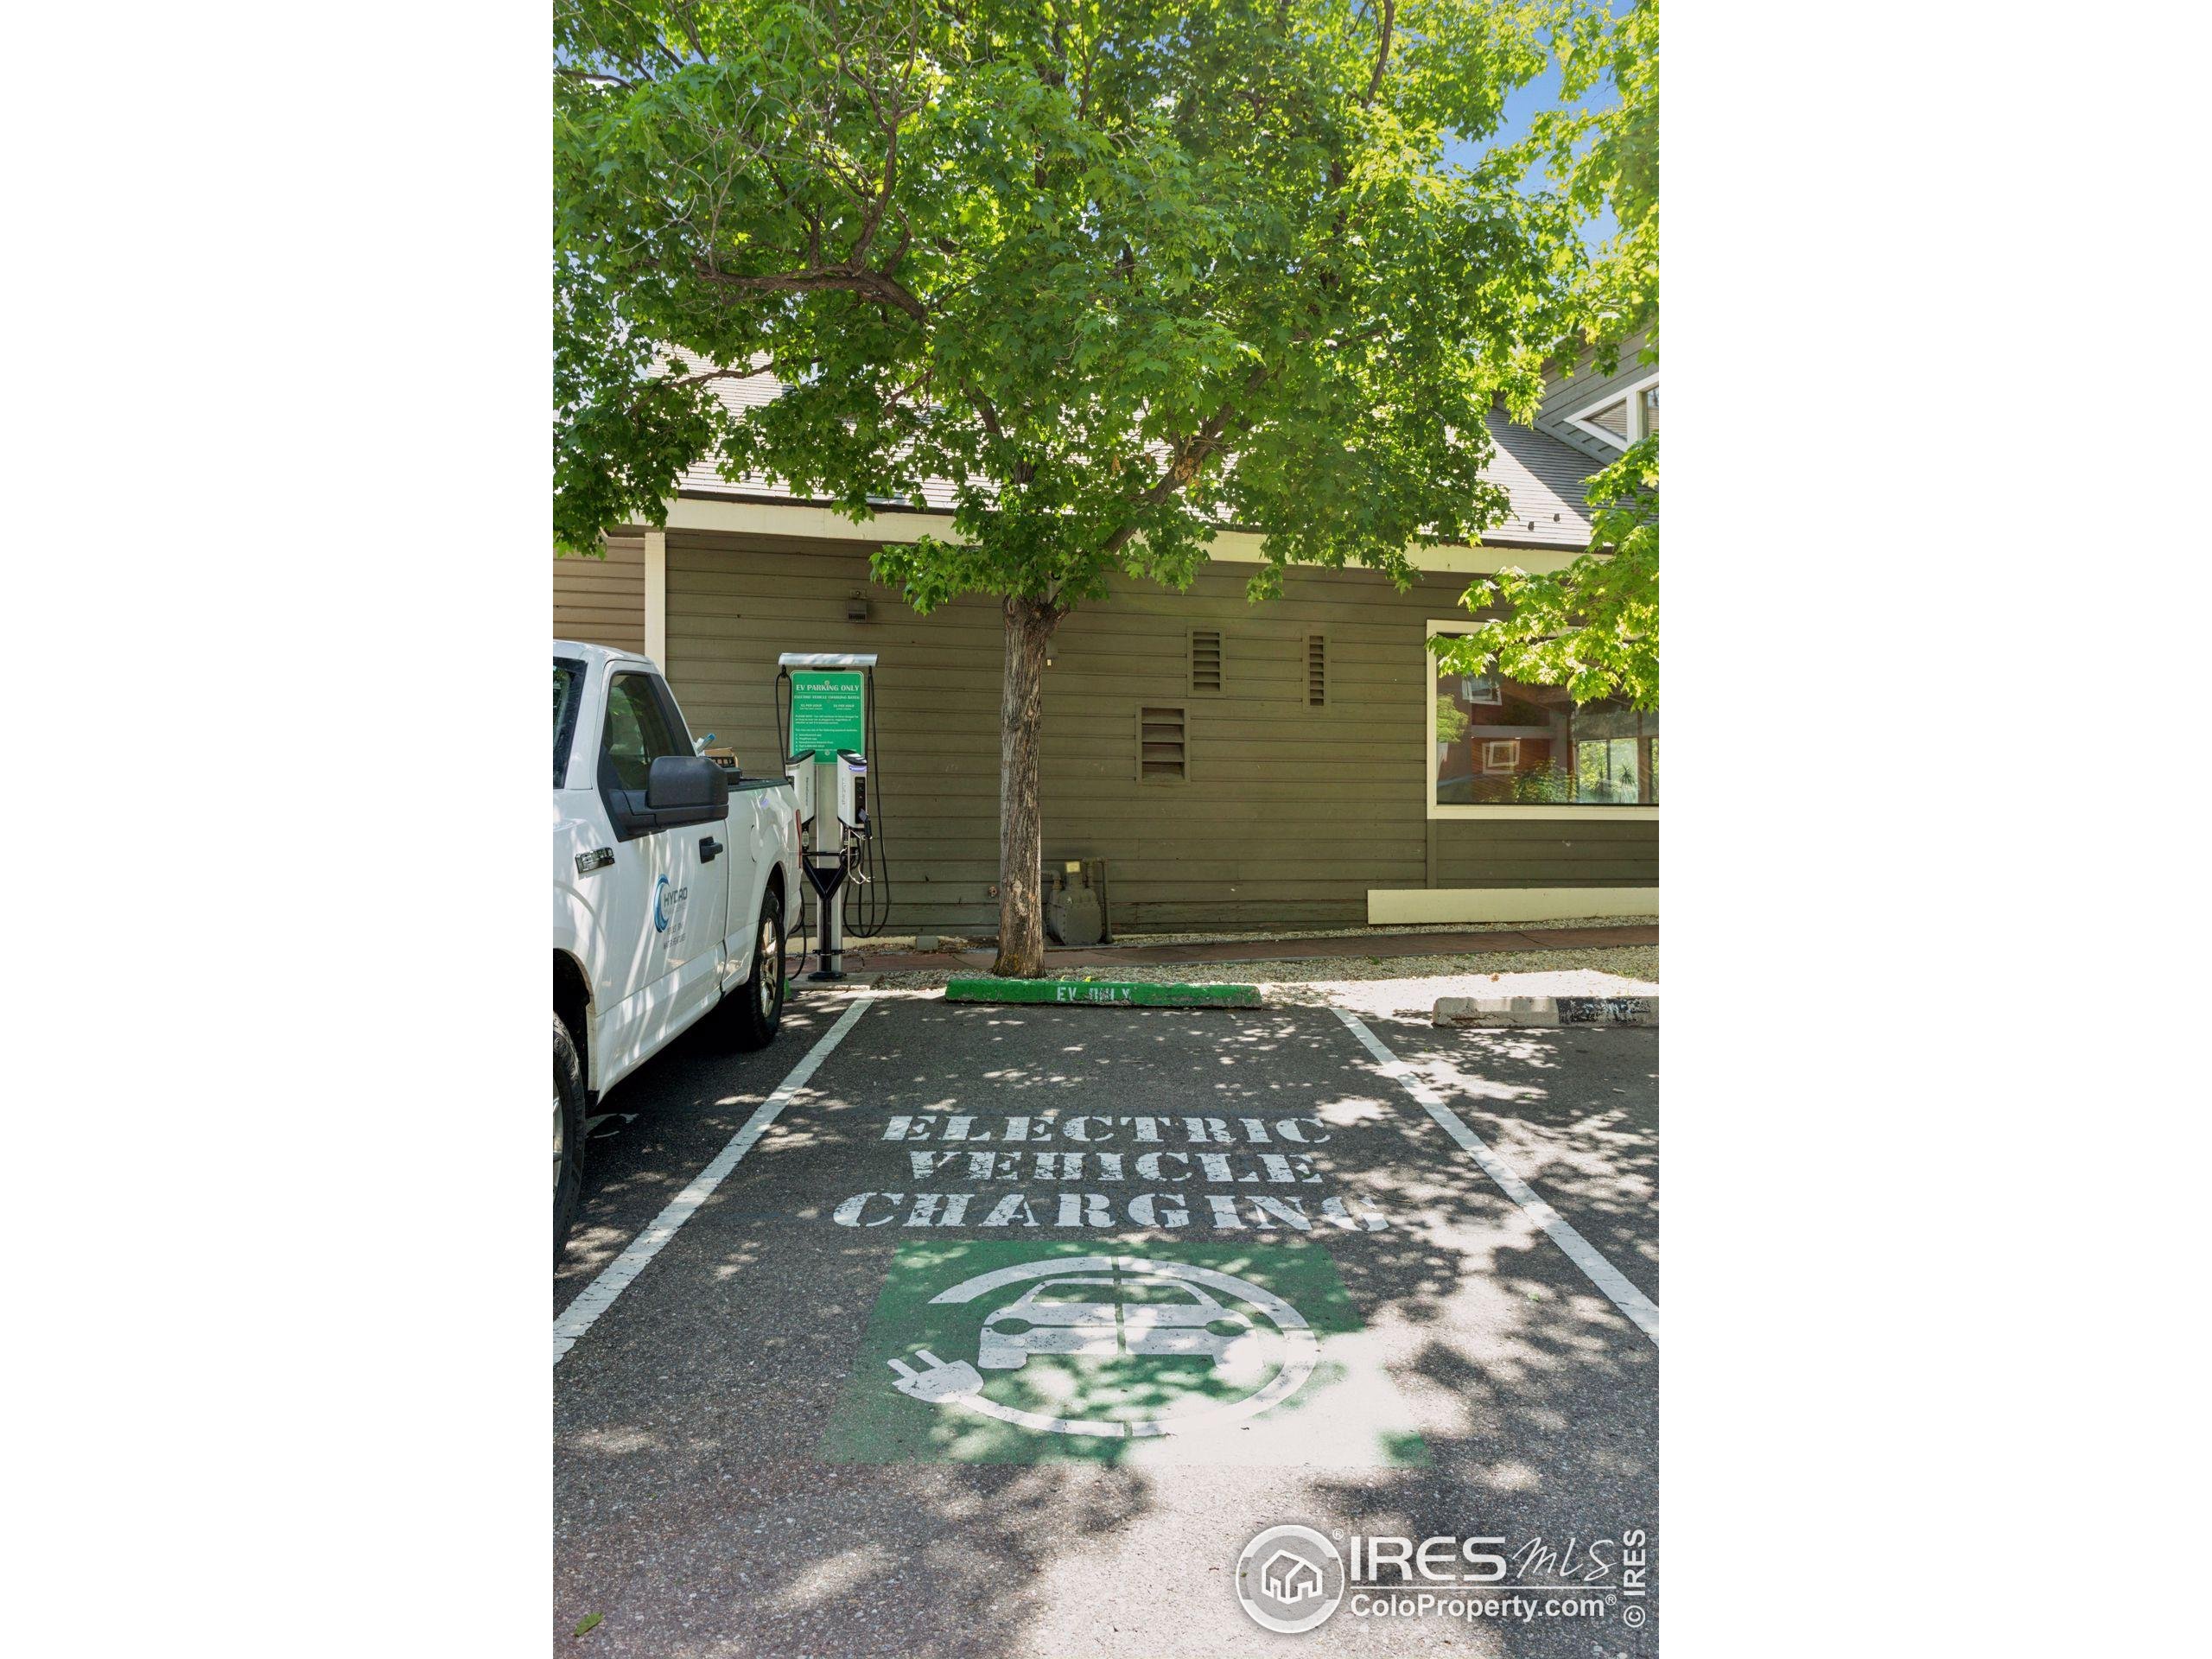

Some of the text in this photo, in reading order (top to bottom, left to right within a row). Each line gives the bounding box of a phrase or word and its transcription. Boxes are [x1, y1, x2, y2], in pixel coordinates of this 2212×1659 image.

[1057, 986, 1077, 1001] EV
[880, 1116, 1332, 1144] ELECTRIC
[908, 1151, 1323, 1183] VEHICLE
[831, 1192, 1389, 1232] CHARGING
